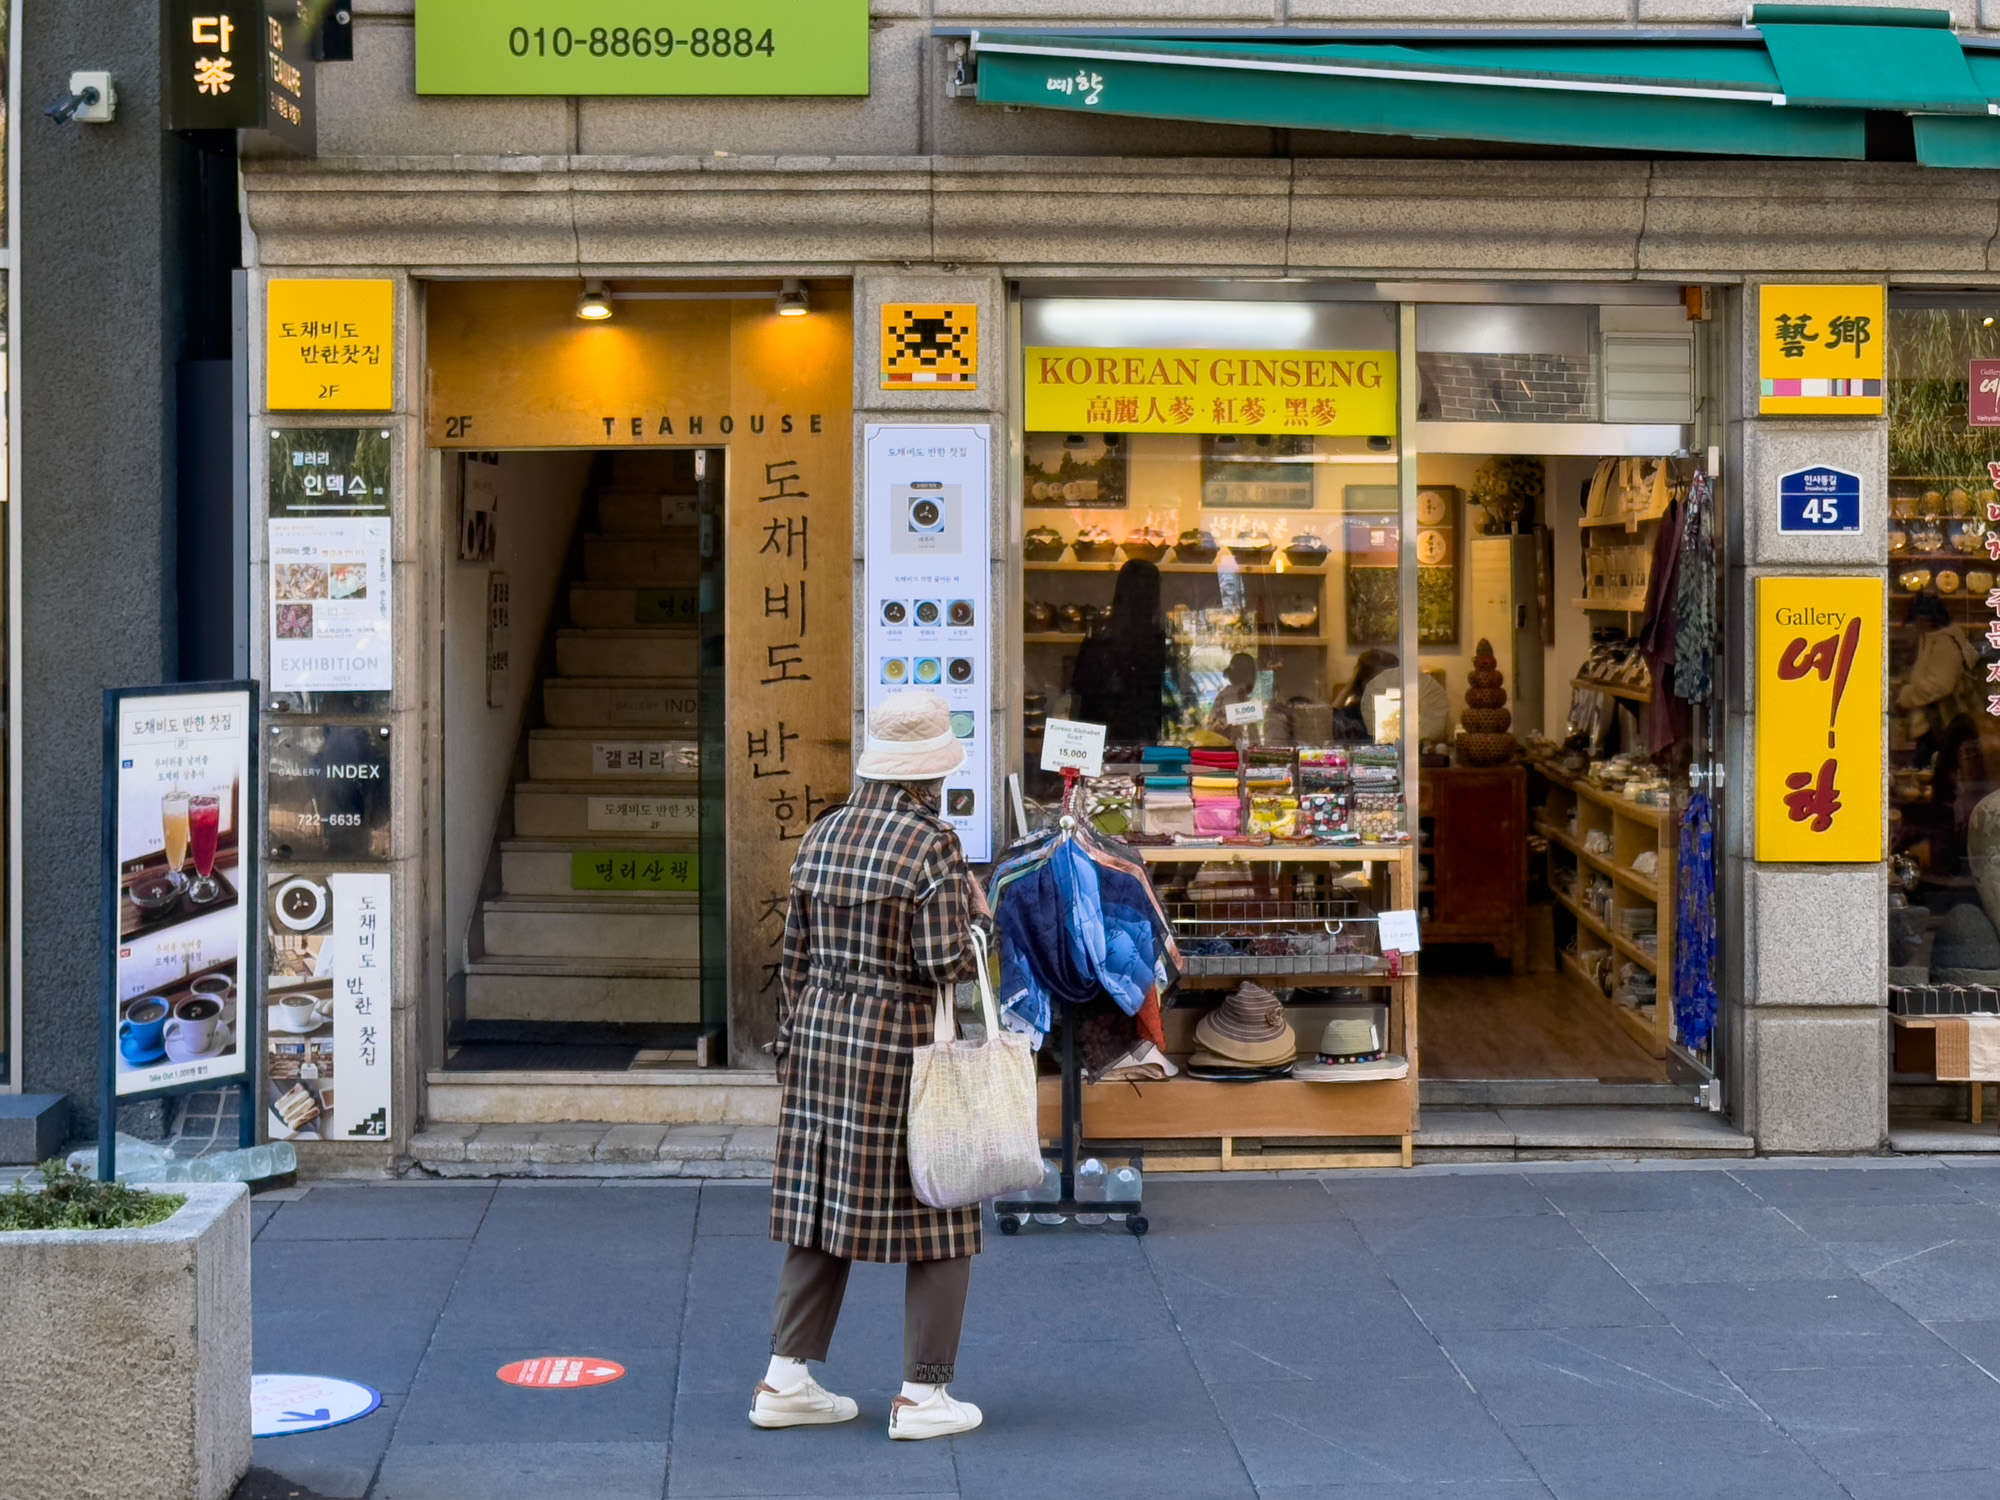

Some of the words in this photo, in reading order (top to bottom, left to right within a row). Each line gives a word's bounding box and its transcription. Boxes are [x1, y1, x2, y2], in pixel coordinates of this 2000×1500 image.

[191, 15, 235, 52] 다
[509, 26, 776, 59] 010-8869-8884
[193, 56, 235, 95] 茶
[278, 321, 359, 339] 도채비도
[300, 344, 380, 365] 반한찻집
[1037, 356, 1200, 386] KOREAN
[1209, 358, 1384, 390] GINSENG
[318, 384, 340, 399] 2F
[445, 415, 473, 438] 2F
[602, 413, 822, 437] TEAHOUSE
[303, 473, 368, 497] 인덱스
[1803, 474, 1837, 486] 인사동길
[1802, 498, 1838, 524] 45
[757, 459, 812, 686] 도채비도
[1775, 607, 1847, 630] Gallery
[281, 657, 379, 671] EXHIBITION
[663, 698, 697, 713] IND
[132, 717, 179, 736] 도채비도
[182, 715, 207, 734] 반한
[209, 714, 232, 732] 찻집
[605, 750, 664, 769] 갤러리
[1058, 748, 1087, 759] 15,000
[326, 764, 380, 779] INDEX
[746, 721, 826, 842] 반한
[298, 814, 361, 826] 722-6635
[604, 803, 651, 817] 도채비도
[655, 803, 680, 817] 반한
[358, 896, 377, 969] 도채비도
[346, 976, 373, 1016] 반한
[359, 1026, 377, 1067] 찻집
[366, 1120, 385, 1135] 2F
